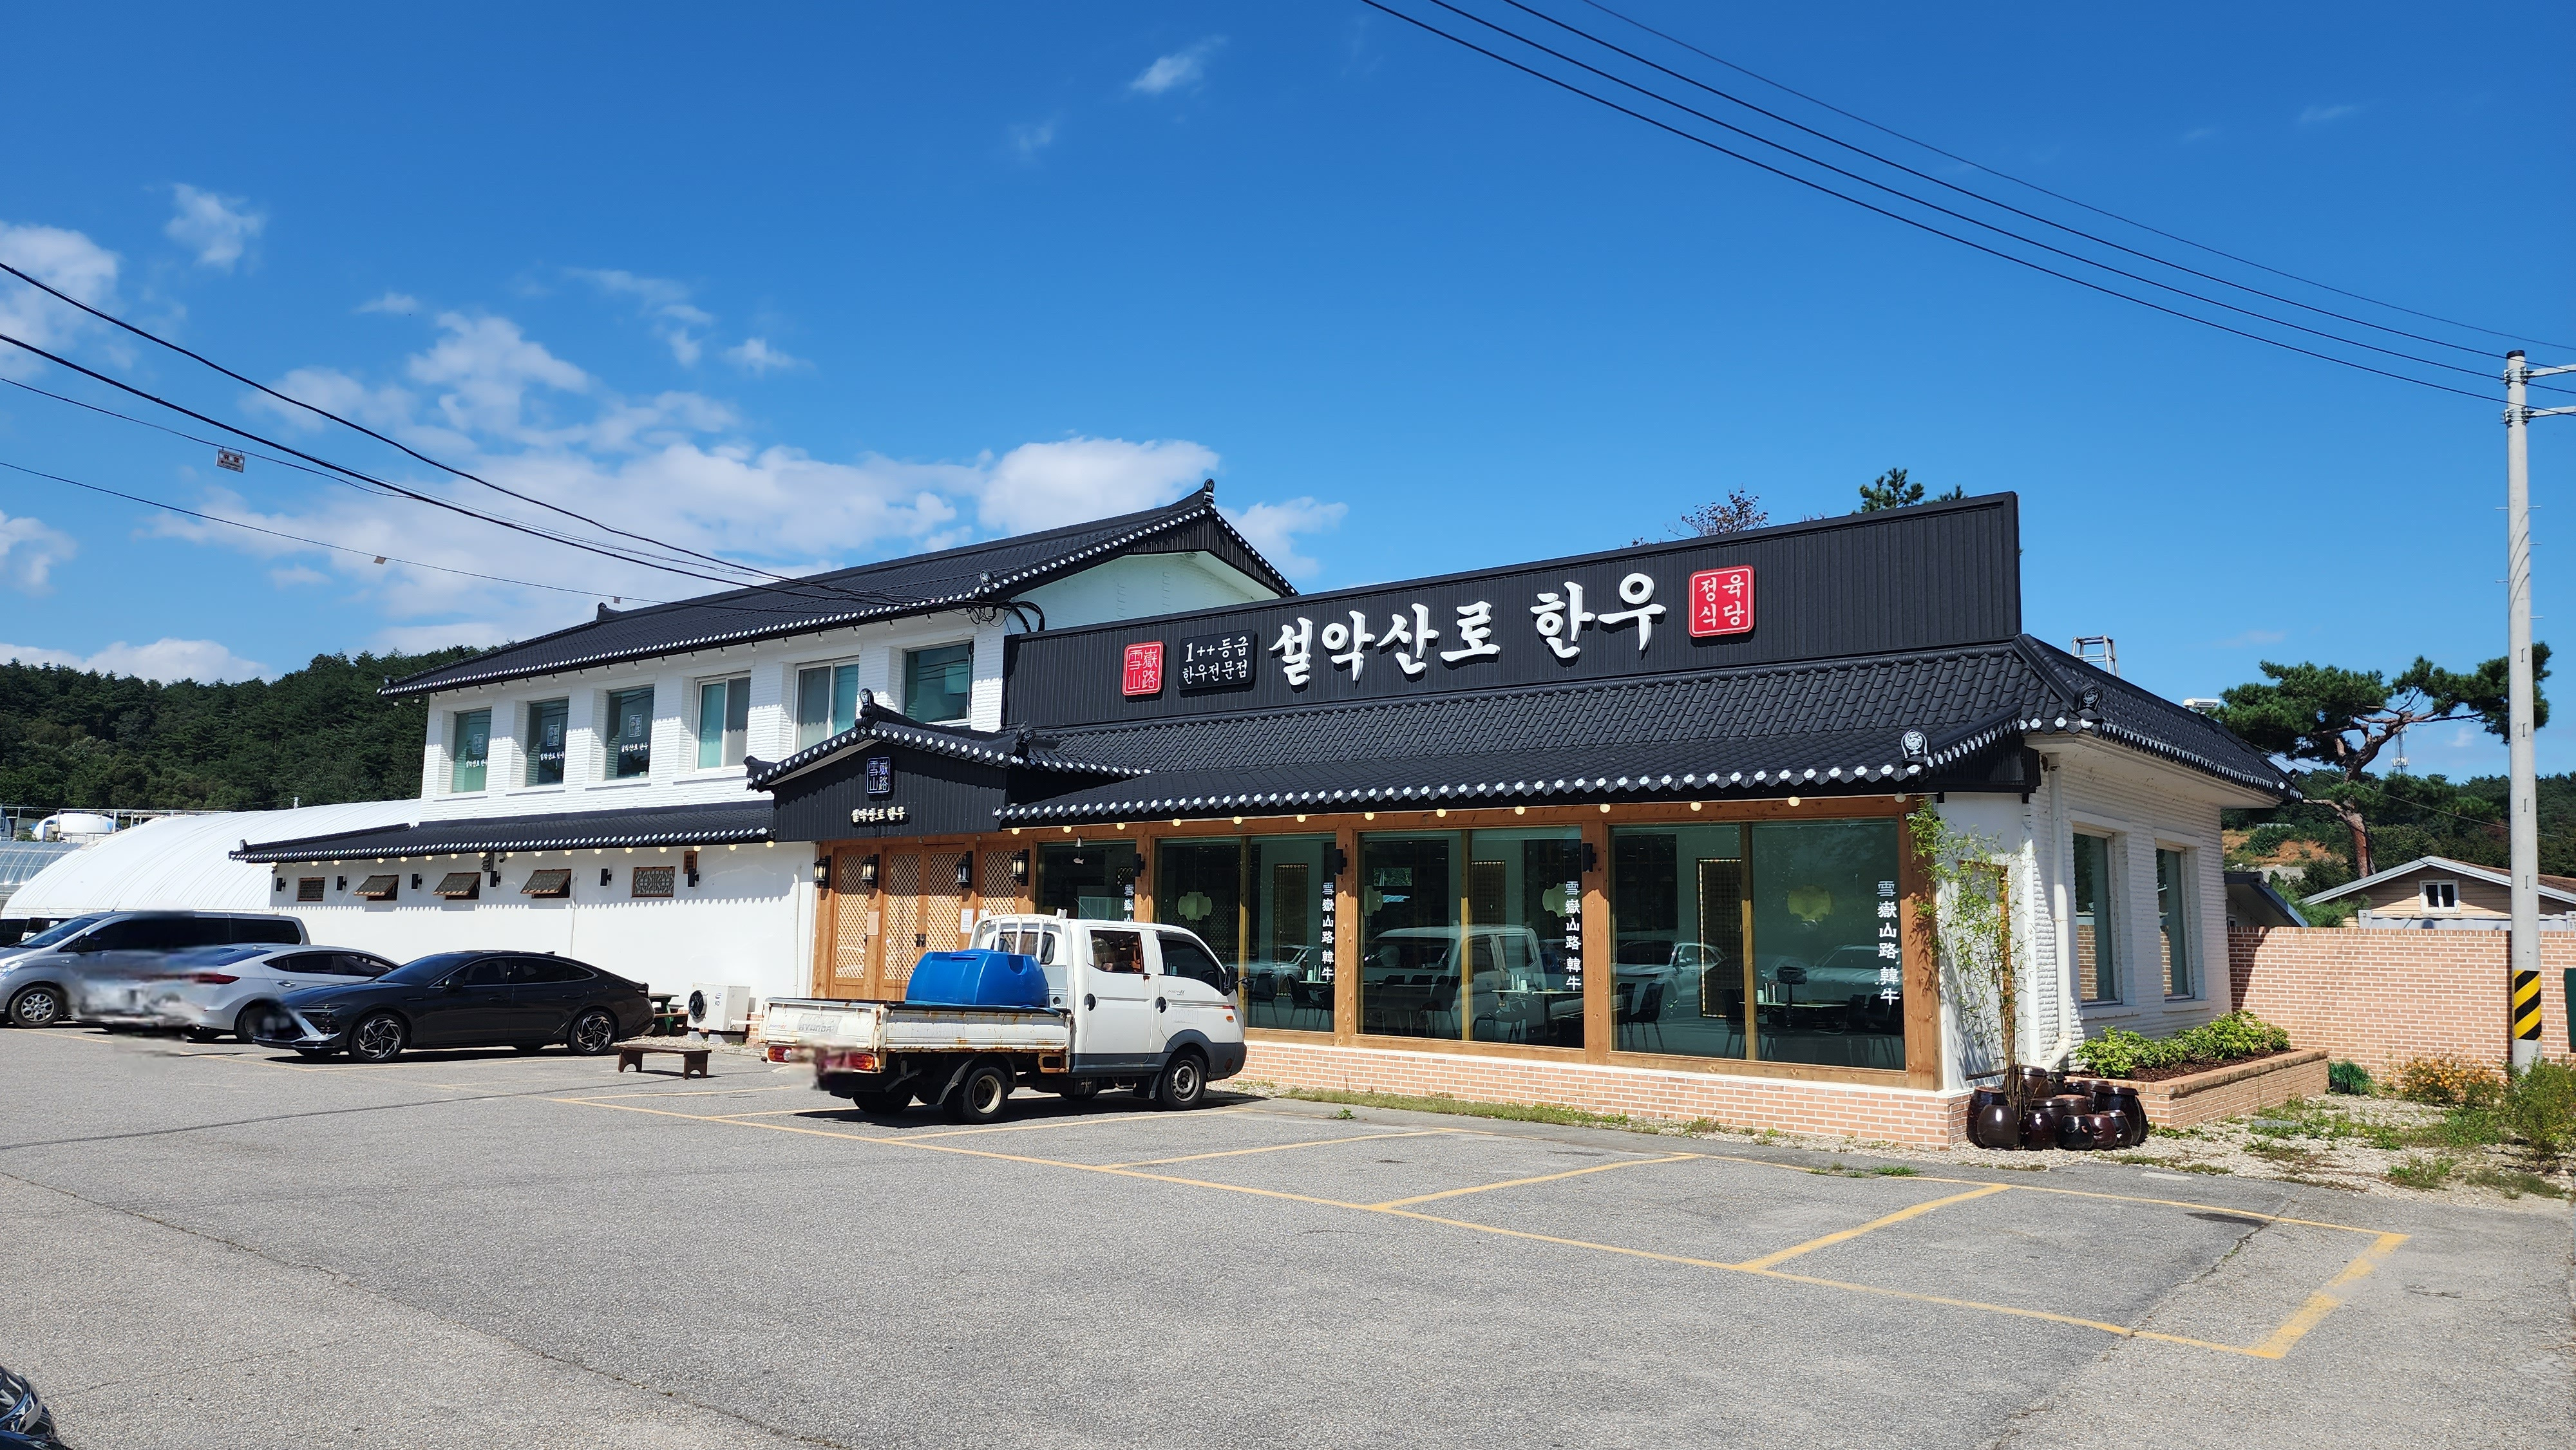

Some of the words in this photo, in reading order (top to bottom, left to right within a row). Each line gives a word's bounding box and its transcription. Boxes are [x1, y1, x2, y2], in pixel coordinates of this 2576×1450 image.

[1698, 574, 1745, 602] 정육
[1698, 601, 1745, 628] 식당
[1269, 601, 1501, 686] 설악산로
[1530, 572, 1667, 659] 한우
[1185, 636, 1249, 663] 1++등급
[1182, 659, 1248, 684] 한우전문점
[851, 807, 886, 823] 설악산로
[887, 806, 905, 821] 한우
